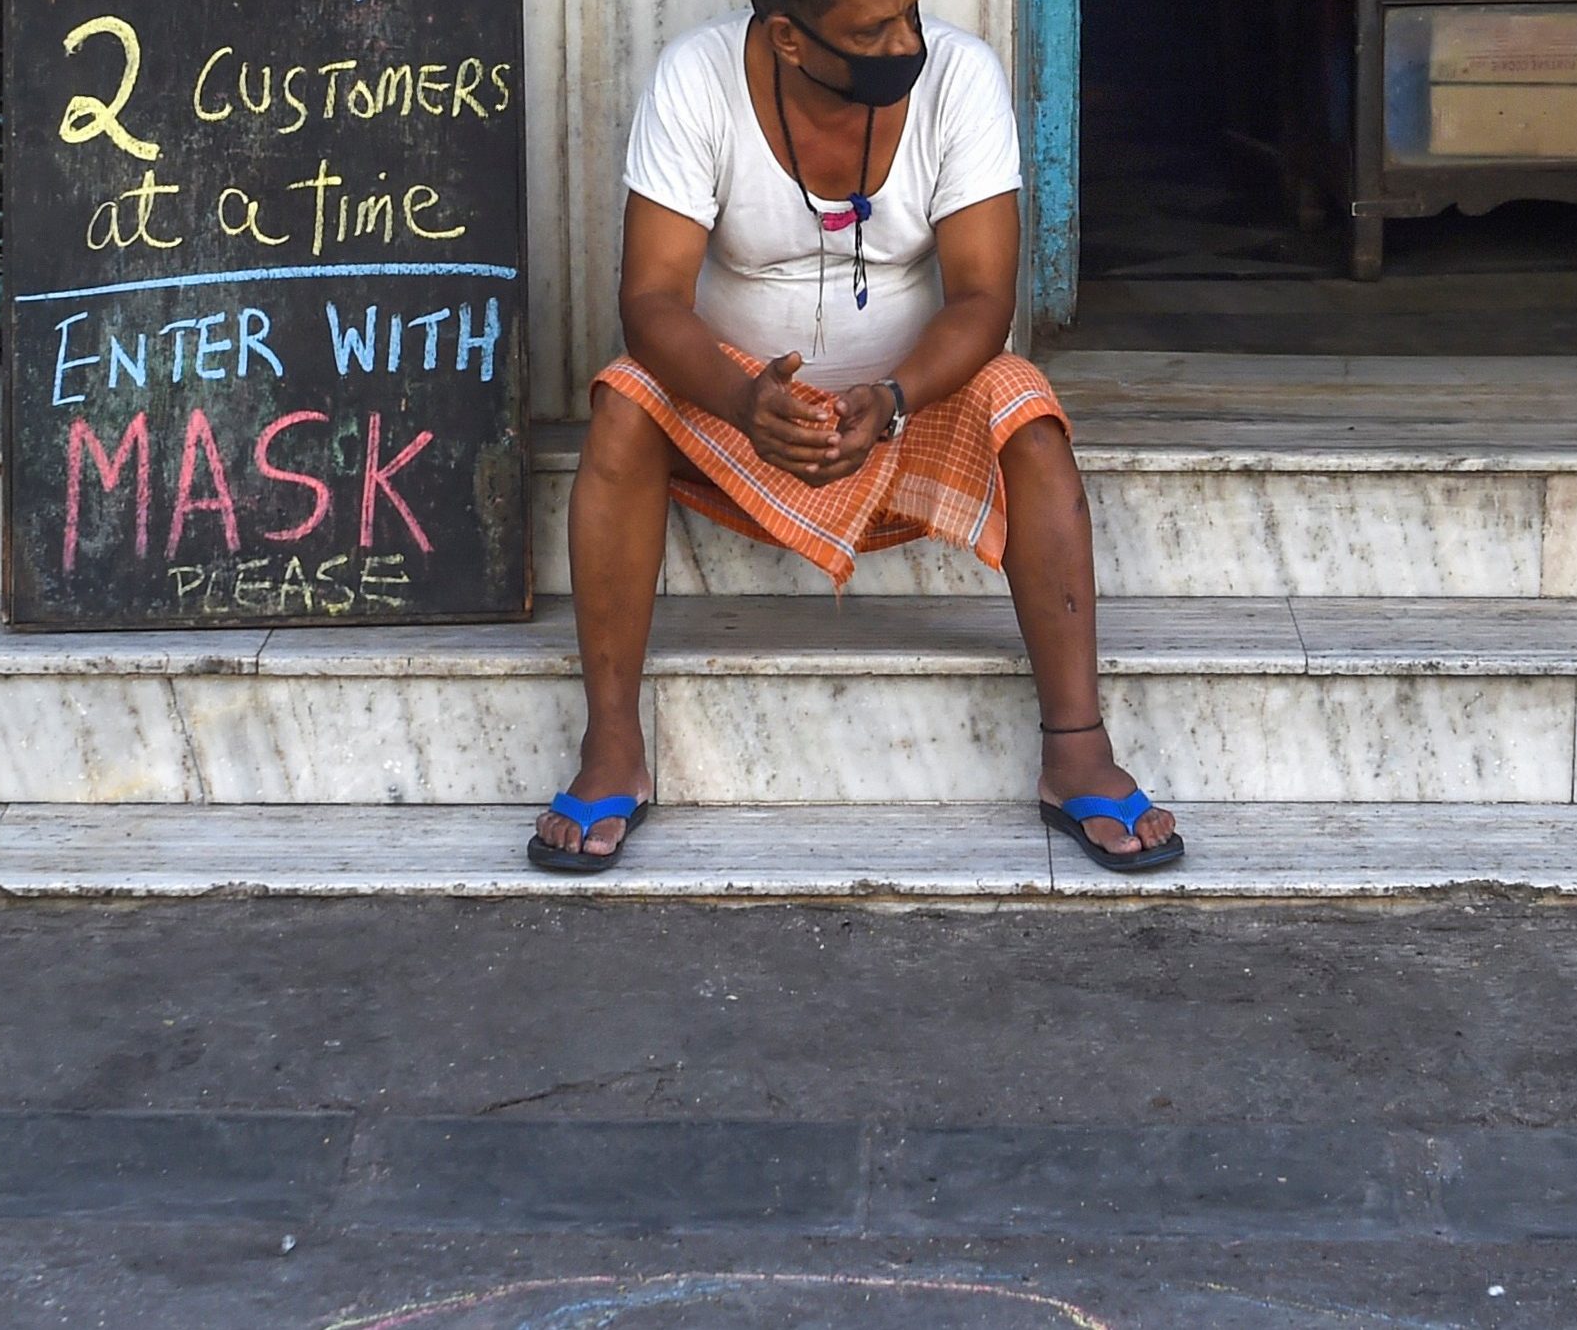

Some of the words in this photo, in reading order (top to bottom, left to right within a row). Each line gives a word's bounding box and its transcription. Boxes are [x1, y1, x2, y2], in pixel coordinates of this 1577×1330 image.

[58, 15, 162, 161] 2
[193, 46, 511, 135] CUSTOMERS
[86, 170, 183, 250] at
[219, 188, 290, 245] a
[286, 159, 468, 256] time
[51, 308, 285, 407] ENTER
[326, 298, 502, 383] WITH
[62, 410, 435, 572] MASK
[166, 554, 412, 615] PLEASE
